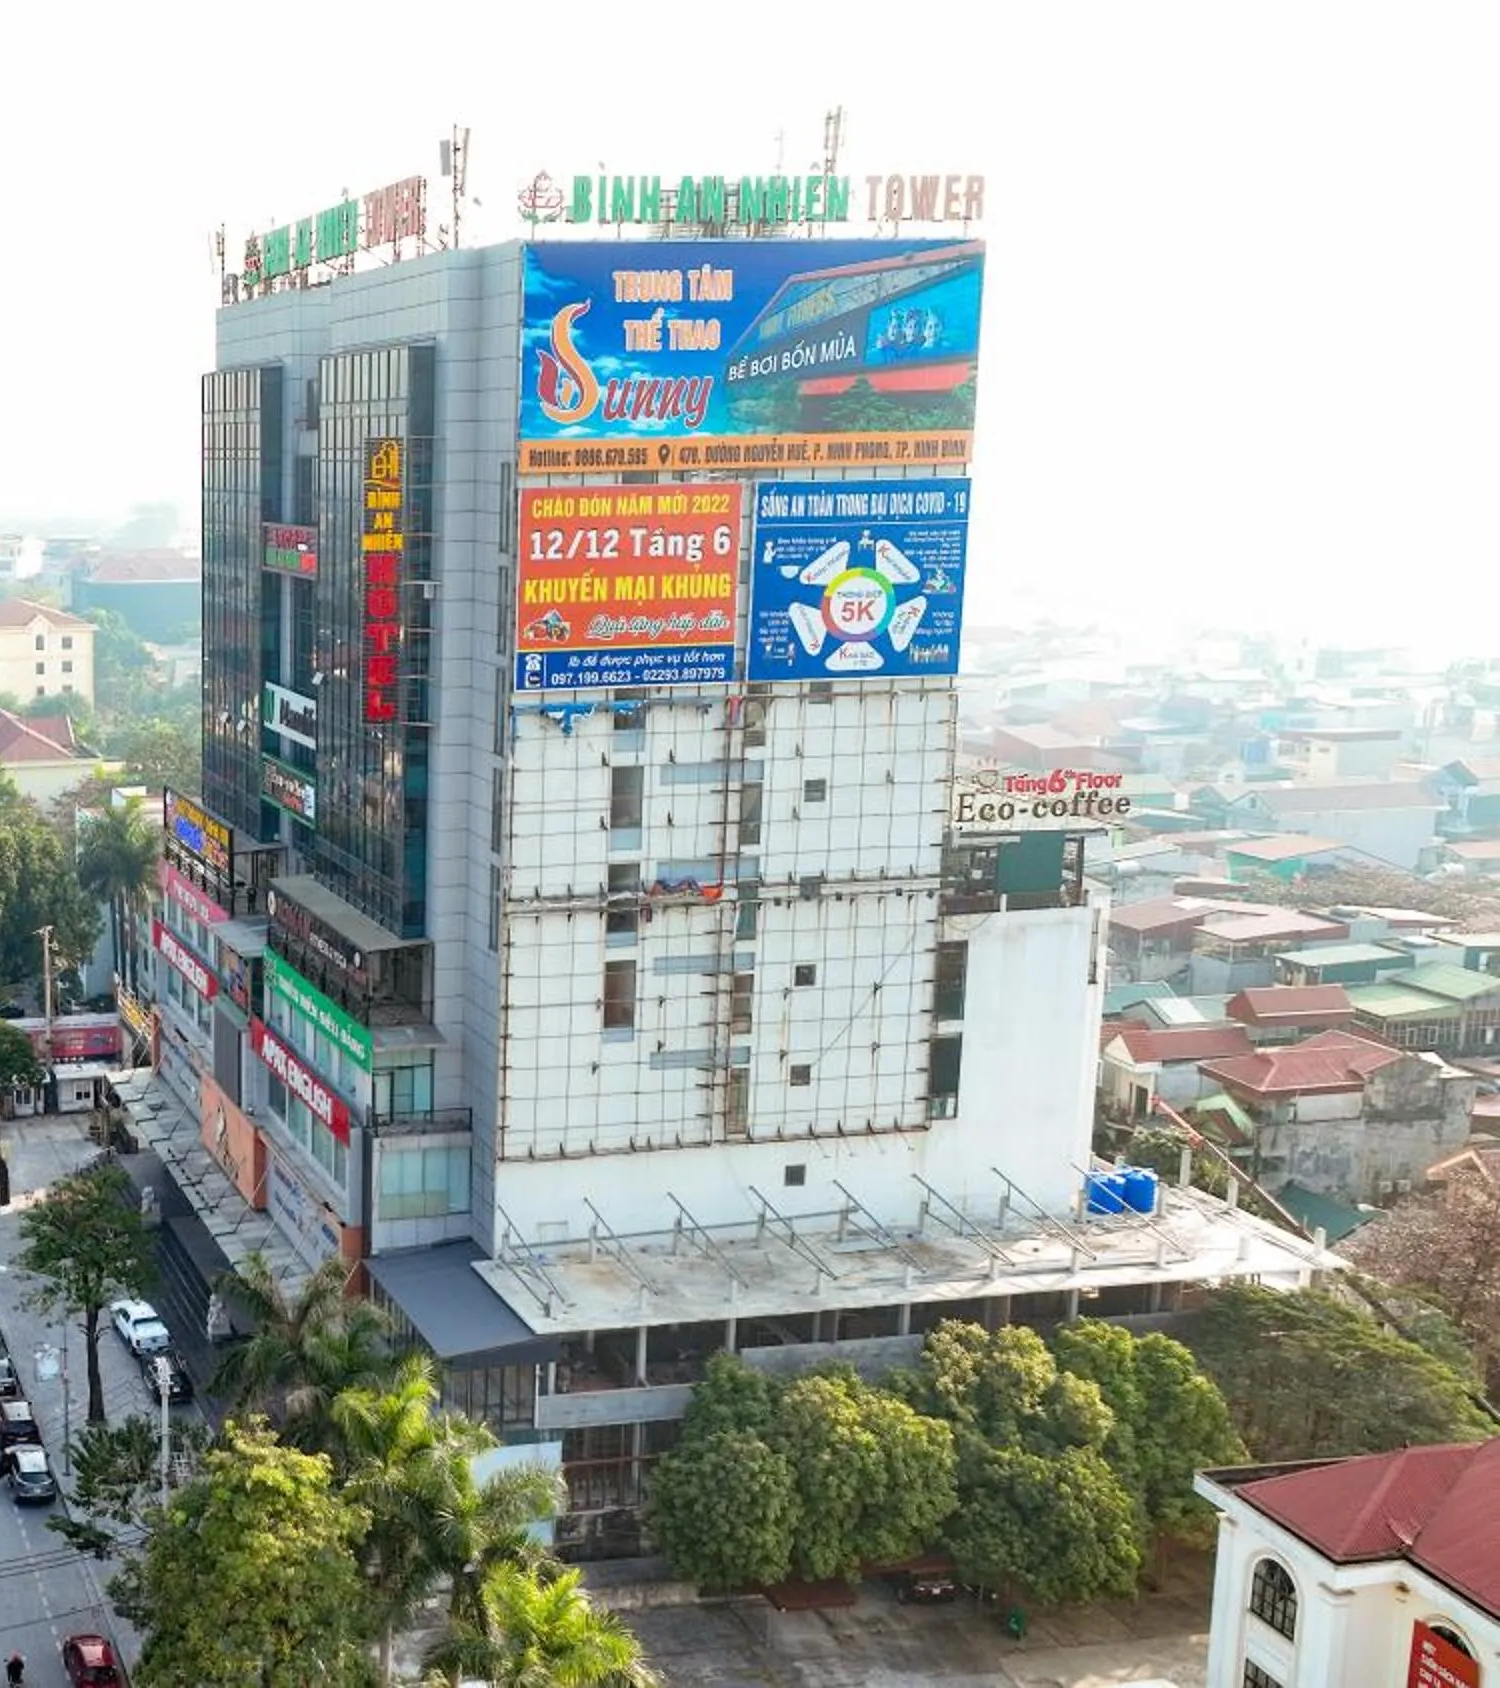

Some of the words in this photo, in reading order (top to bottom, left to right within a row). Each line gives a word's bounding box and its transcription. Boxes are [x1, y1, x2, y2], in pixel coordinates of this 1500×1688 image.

[573, 161, 660, 223] BÌNH
[676, 175, 725, 223] AN
[740, 161, 849, 223] NHIÊN
[865, 175, 987, 223] TOWER
[612, 270, 683, 302] TRUNG
[687, 263, 734, 302] TÂM
[668, 318, 721, 351] THAO
[536, 298, 714, 428] Sunny
[750, 354, 777, 375] BƠI
[781, 339, 816, 370] BỐN
[820, 331, 856, 363] MÙA
[529, 448, 571, 467] Hotline:
[616, 493, 653, 516] NĂM
[658, 490, 687, 515] MỚI
[692, 494, 730, 514] 2022
[790, 497, 805, 517] AN
[836, 493, 868, 516] TRONG
[916, 491, 945, 515] COVID
[953, 492, 966, 514] 19
[530, 528, 620, 560] 12/12
[630, 526, 704, 562] Tầng
[714, 525, 732, 556] 6
[525, 568, 608, 604] KHUYẾN
[615, 574, 654, 607] MẠI
[661, 564, 731, 600] KHỦNG
[842, 600, 875, 622] 5K
[366, 554, 399, 721] HOTEL
[1076, 772, 1122, 790] Floor
[956, 789, 1131, 823] Eco-coffee
